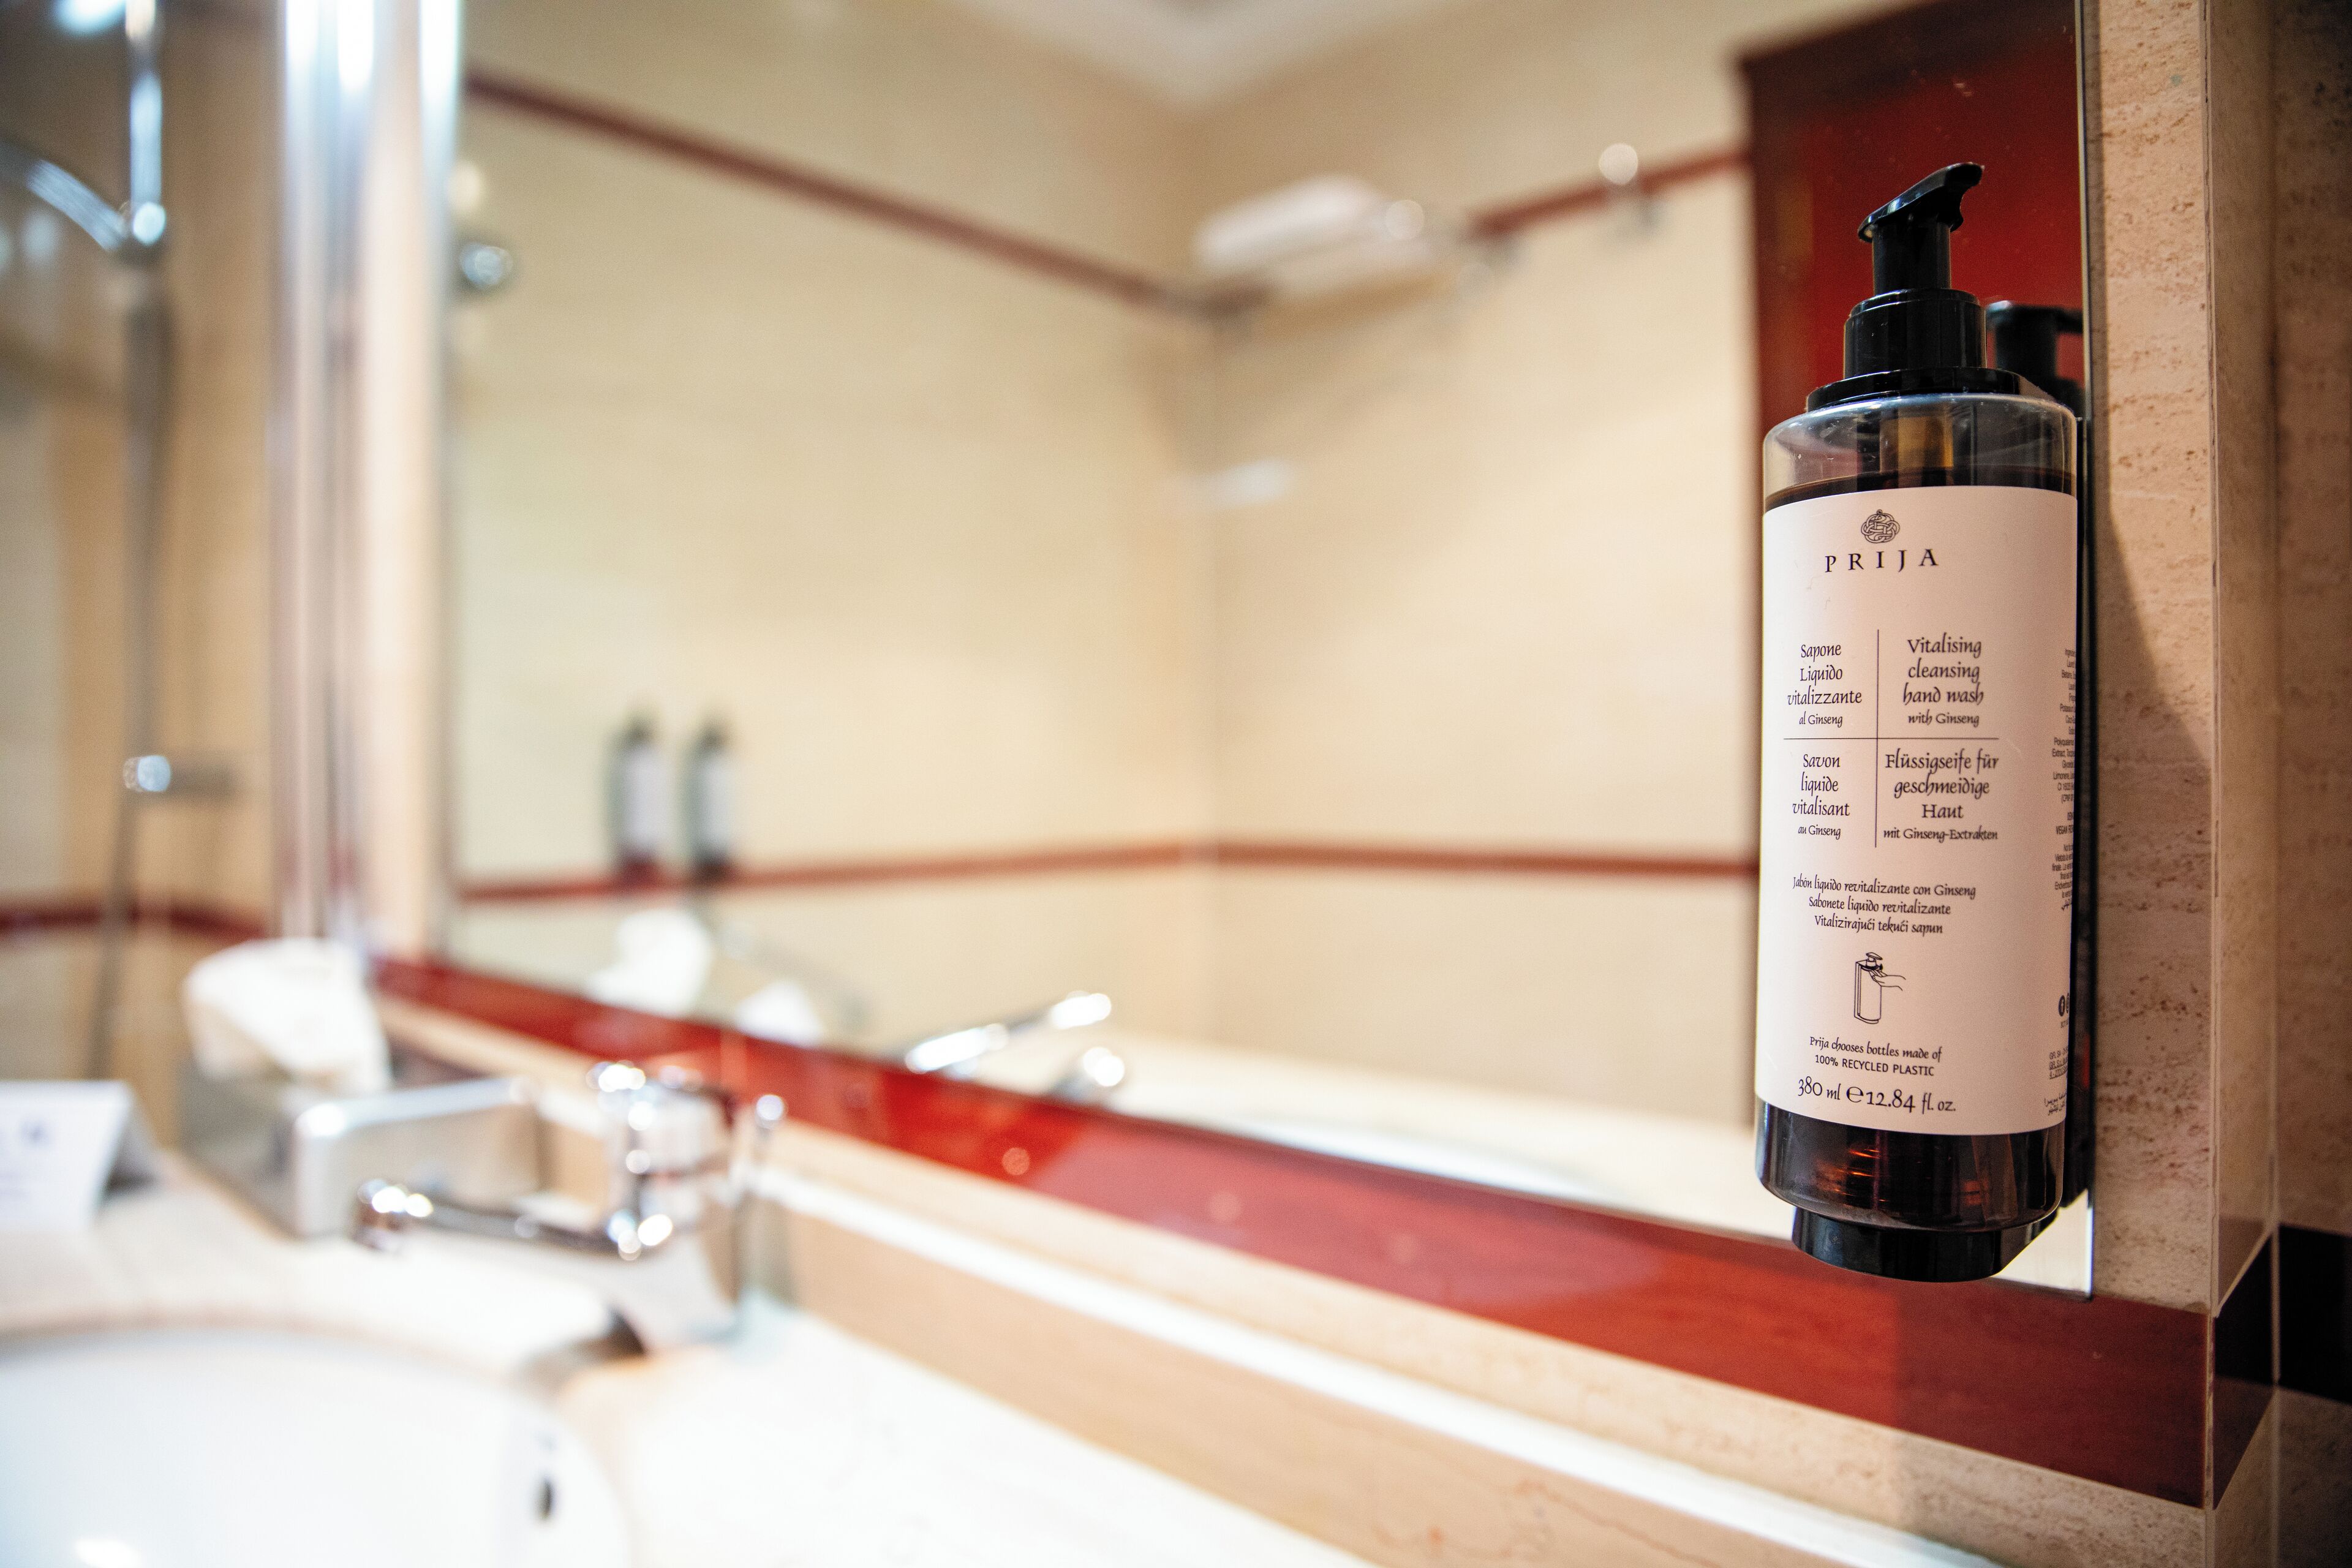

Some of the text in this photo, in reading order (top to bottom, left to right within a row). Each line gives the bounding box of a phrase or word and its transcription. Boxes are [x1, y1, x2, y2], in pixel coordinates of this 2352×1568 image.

[1825, 549, 1938, 573] PRIJA
[1801, 644, 1842, 663] Sapone
[1907, 631, 1982, 659] Vitalising
[1800, 664, 1843, 687] Liquido
[1907, 656, 1981, 684] cleansing
[1787, 684, 1863, 706] vitalizzante
[1902, 680, 1985, 706] hand wash
[1798, 710, 1843, 728] al Ginseng
[1907, 709, 1980, 728] with Ginseng
[1803, 753, 1841, 768] Savon
[1885, 747, 1999, 776] Flüssigseife für
[1801, 771, 1839, 795] liquide
[1893, 771, 1990, 800] geschmeidige
[1792, 794, 1850, 816] vitalisant
[1921, 804, 1964, 819] Haut
[1808, 824, 1841, 840] Ginseng
[1883, 824, 1999, 844] mit Ginseng-Extrakten
[1792, 873, 1812, 889] Jabón
[1844, 878, 1910, 895] revitalizante
[1913, 886, 1931, 895] con
[1933, 883, 1977, 900] Ginseng
[1809, 894, 1951, 915] Sabonete liquido revitalizante
[1814, 913, 1943, 937] Vitalizirajući tekući sapun
[1809, 1036, 1943, 1063] Prija chooses bottles made of
[1815, 1054, 1935, 1077] 100% RECYCLED PLASTIC
[1798, 1076, 1823, 1097] 380
[1826, 1083, 1842, 1101] ml
[1866, 1088, 1916, 1114] 12.84
[1921, 1092, 1934, 1115] fl.
[1937, 1101, 1956, 1112] oz.
